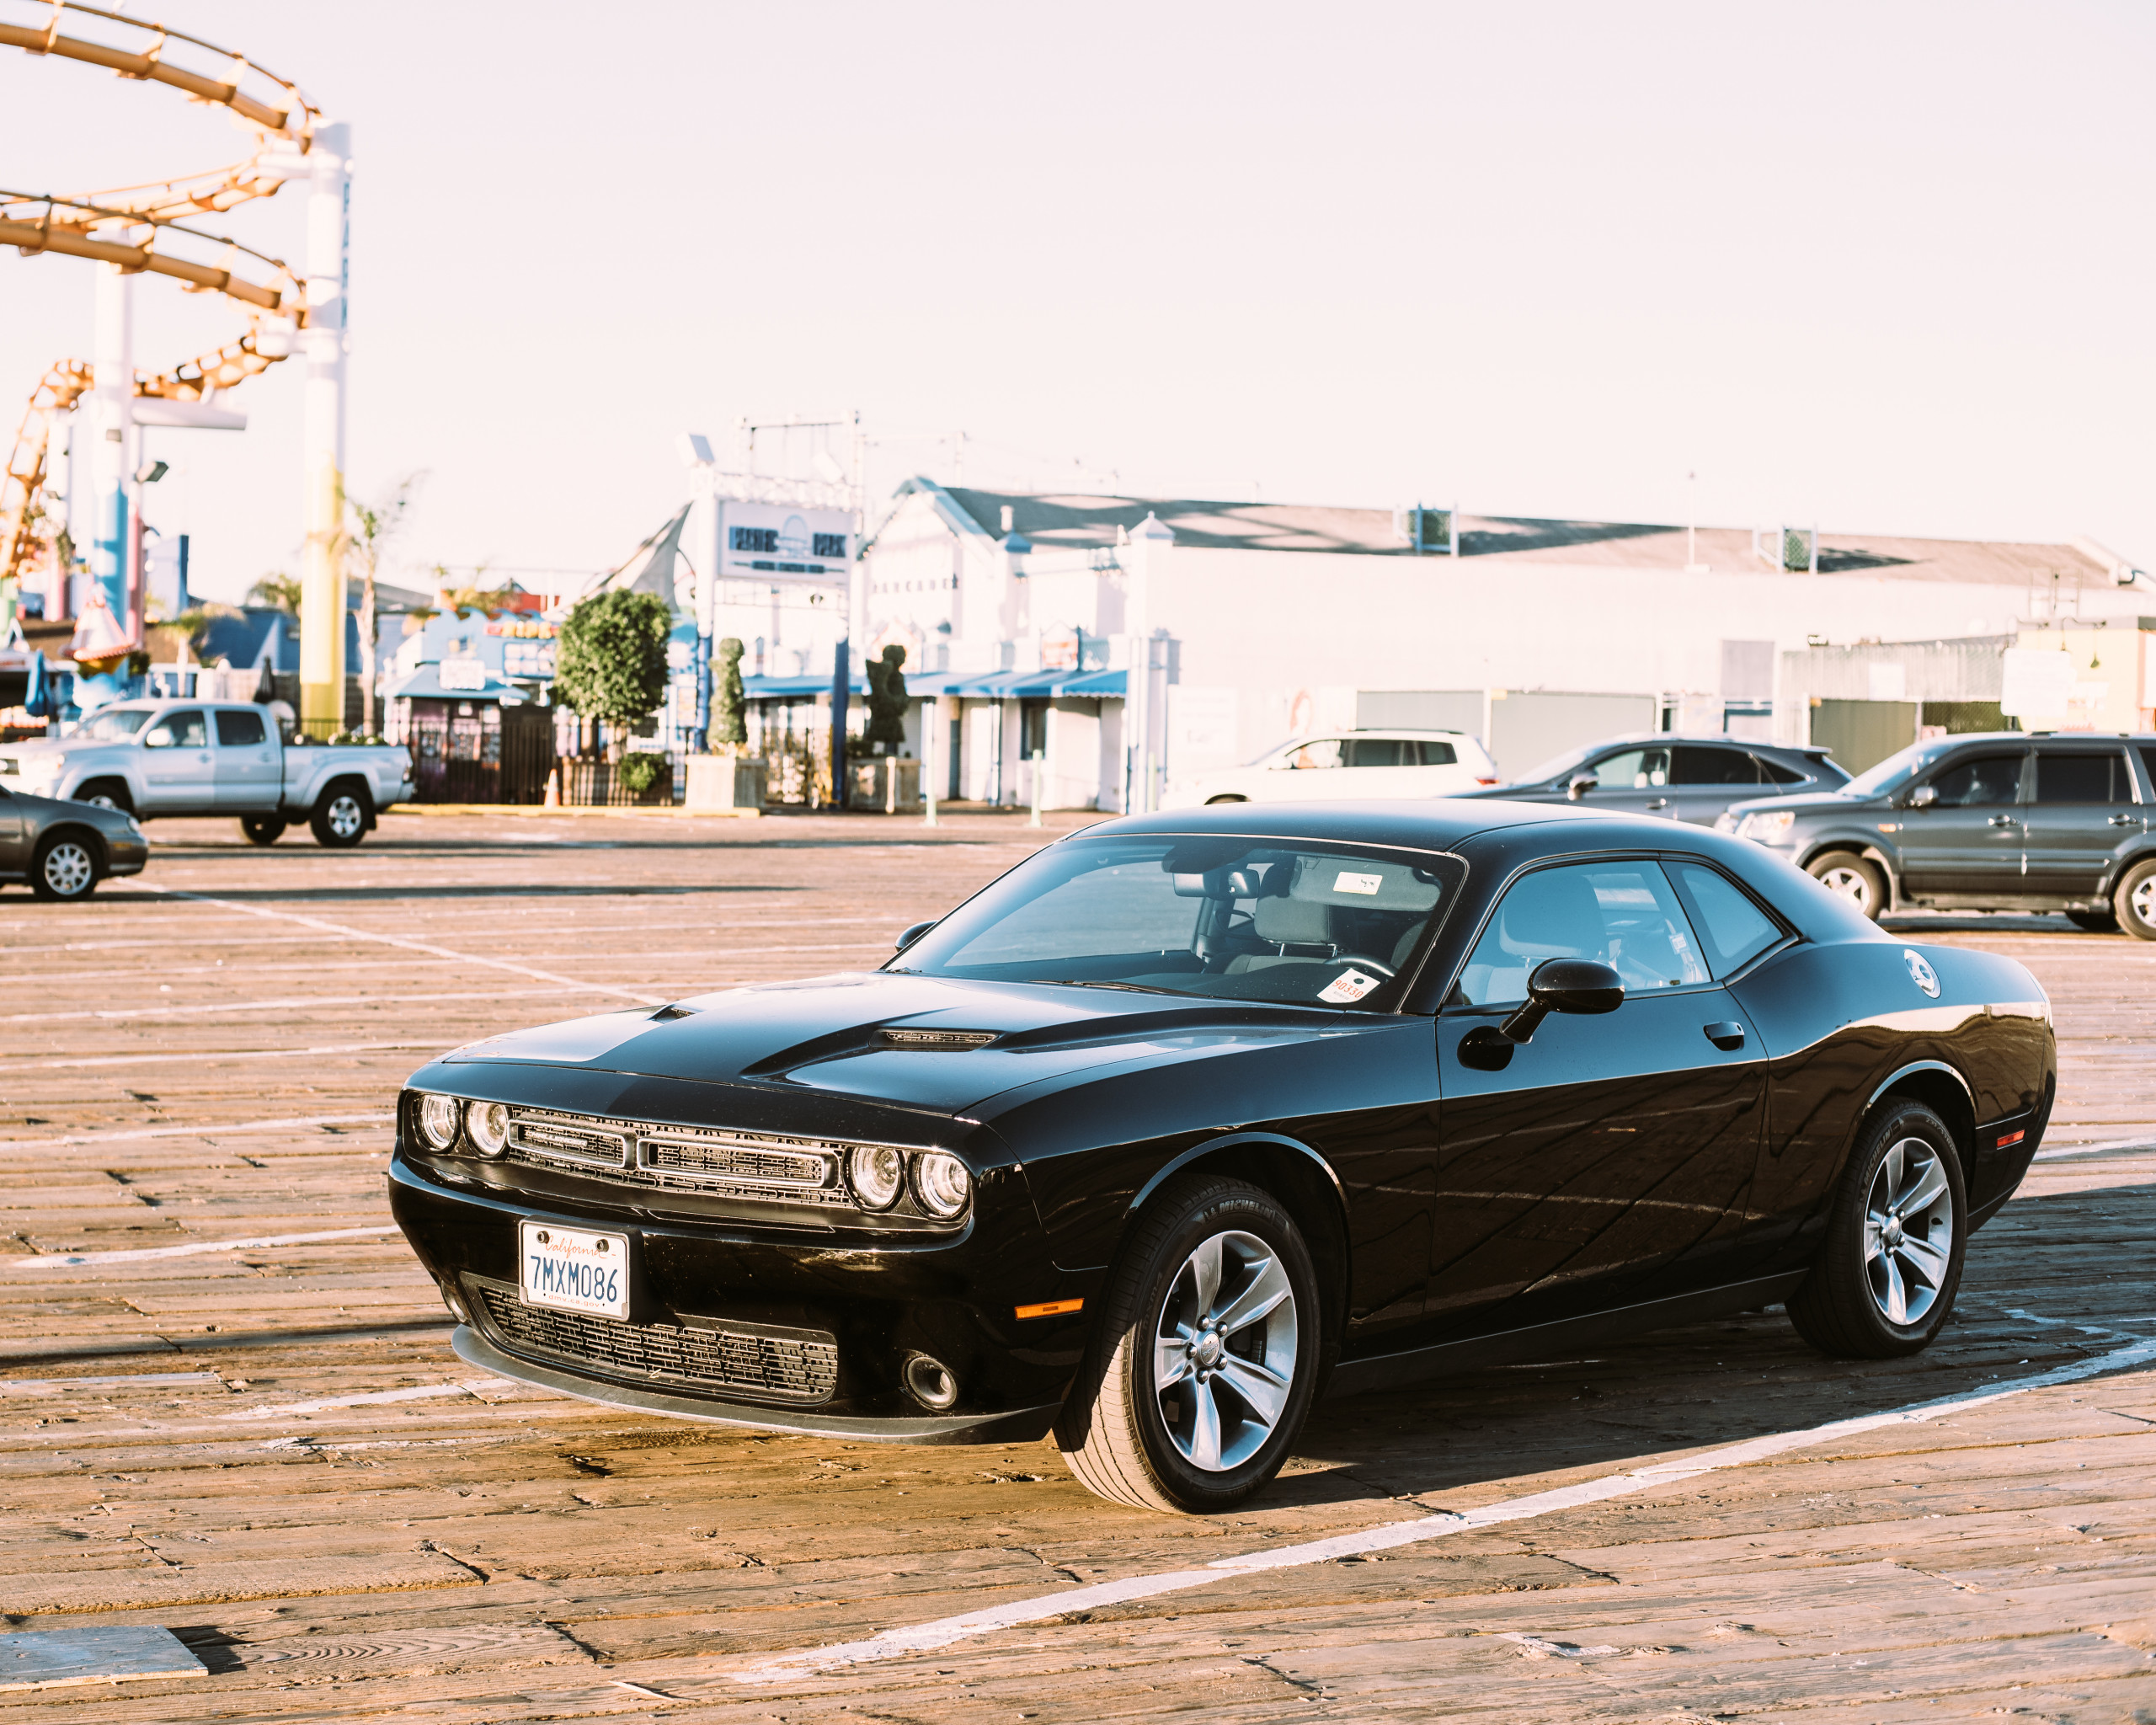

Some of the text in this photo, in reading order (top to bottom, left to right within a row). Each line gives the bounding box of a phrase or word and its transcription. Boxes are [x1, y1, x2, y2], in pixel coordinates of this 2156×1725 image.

[1332, 980, 1364, 998] 90330
[1219, 1199, 1273, 1218] MICHELIN
[545, 1235, 607, 1258] California
[531, 1255, 617, 1302] 7MXM086
[548, 1295, 600, 1307] dmv.ca.gov
